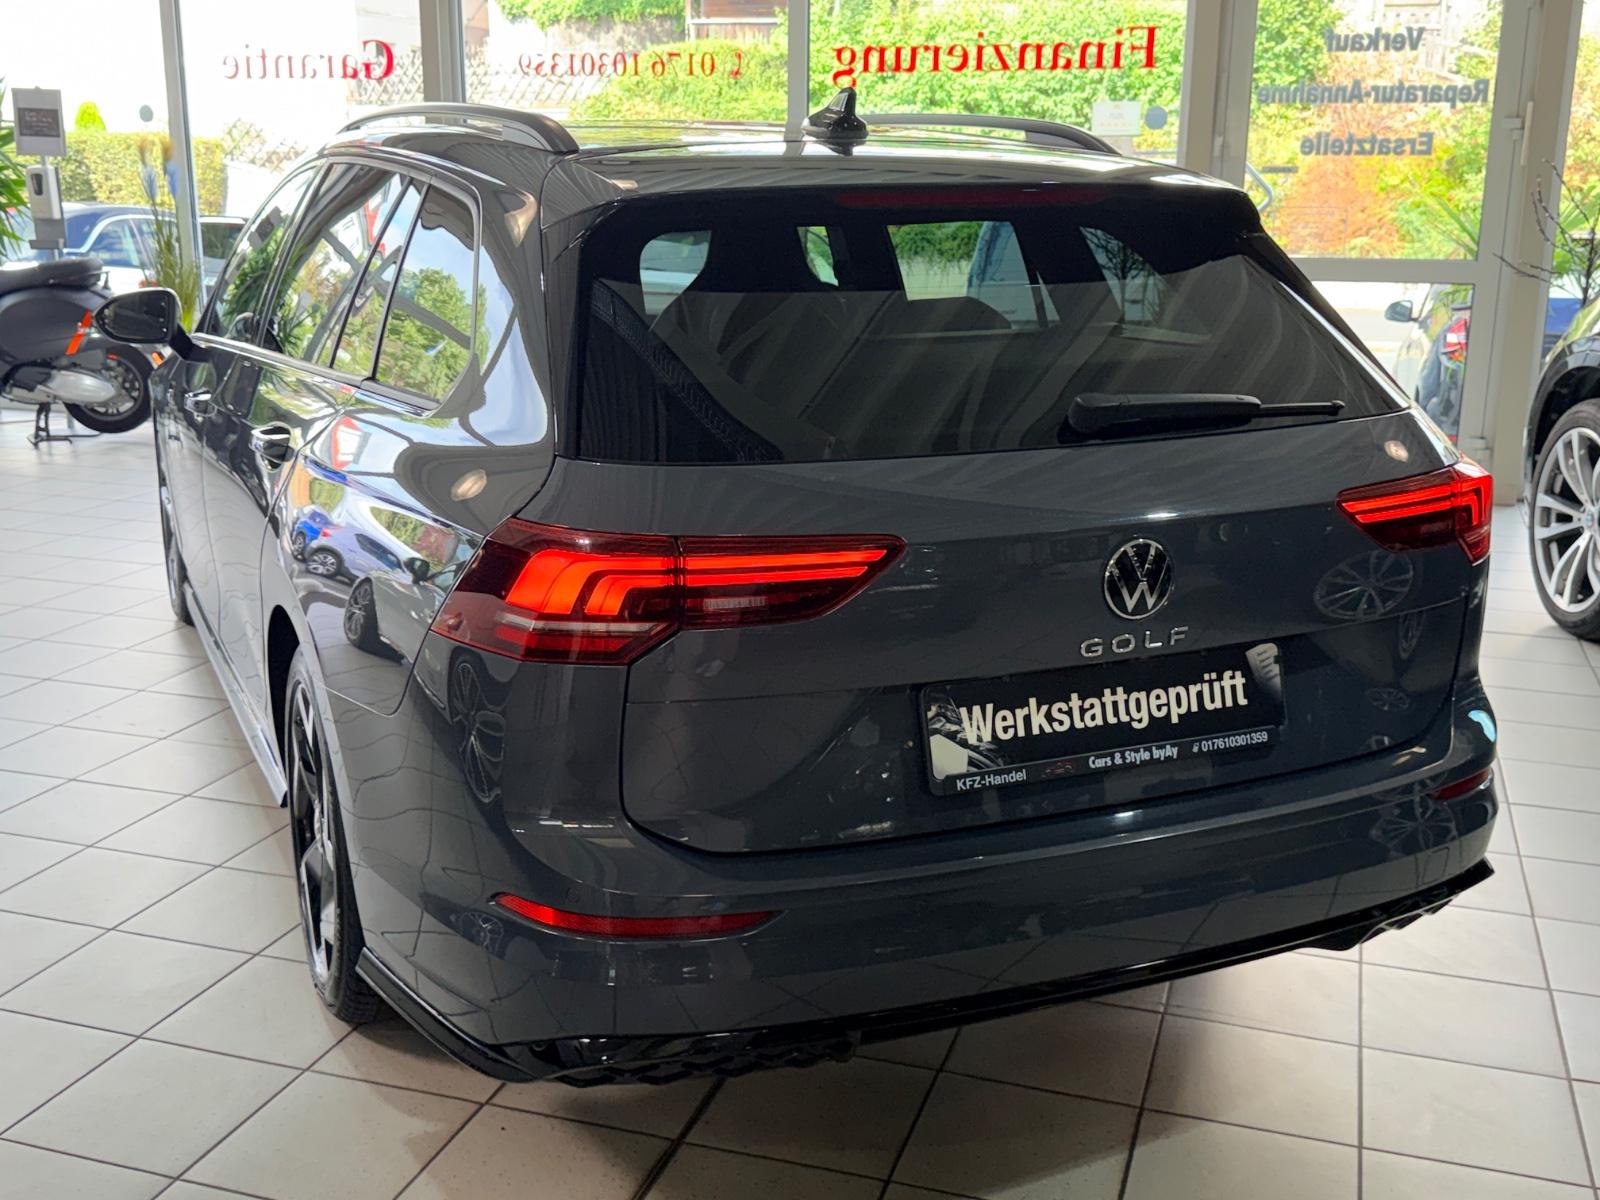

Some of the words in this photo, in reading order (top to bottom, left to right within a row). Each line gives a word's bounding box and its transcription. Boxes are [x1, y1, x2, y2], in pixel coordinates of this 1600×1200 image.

[1080, 626, 1189, 657] GOLF
[960, 670, 1249, 745] Werkstattgeprüft
[1201, 731, 1268, 751] 017610301359
[1088, 754, 1111, 769] Cars
[1114, 752, 1123, 764] &
[1125, 747, 1150, 764] Style
[956, 768, 1027, 791] KFZ-Handel
